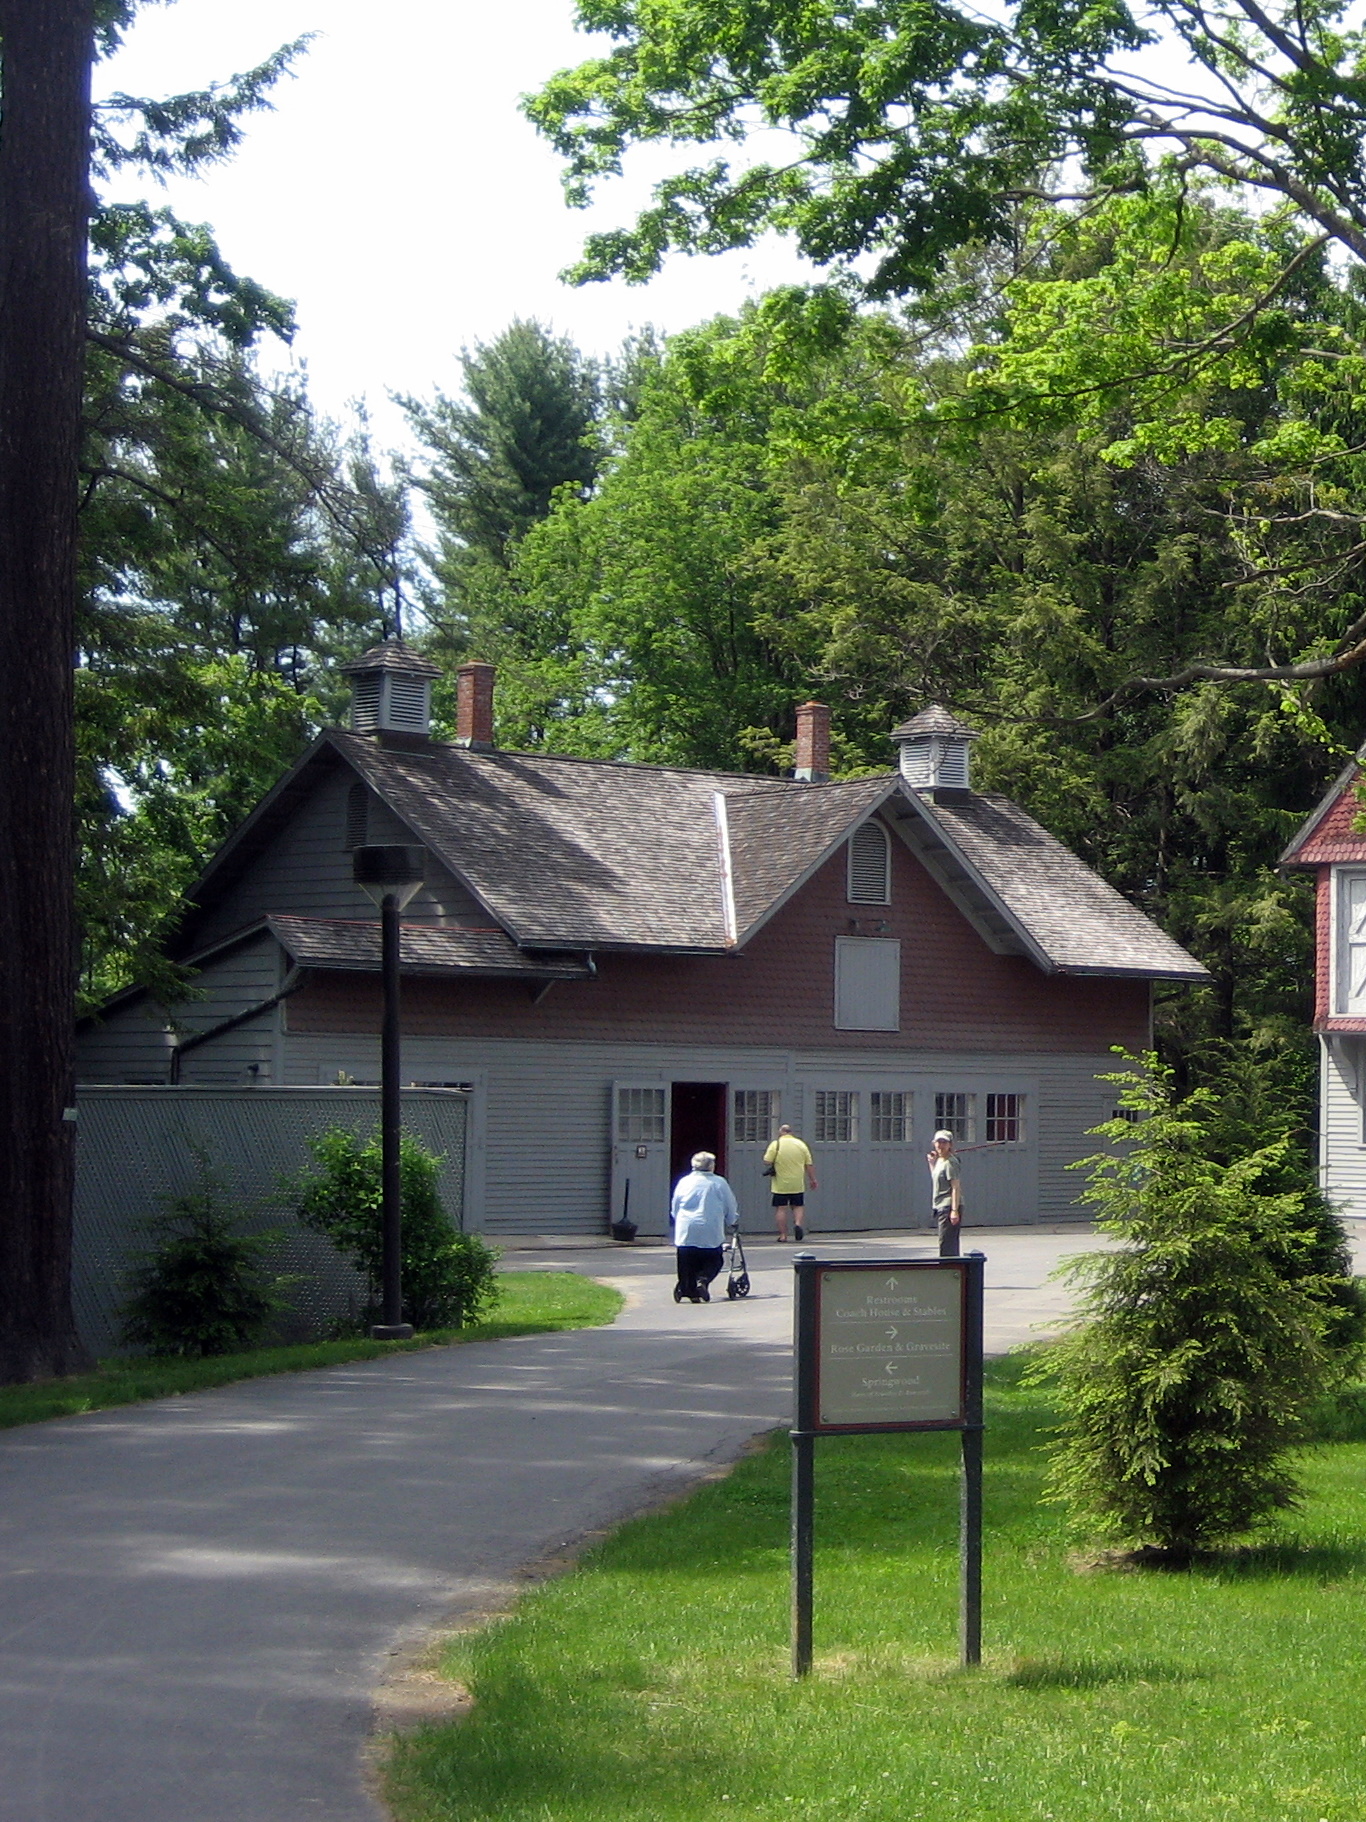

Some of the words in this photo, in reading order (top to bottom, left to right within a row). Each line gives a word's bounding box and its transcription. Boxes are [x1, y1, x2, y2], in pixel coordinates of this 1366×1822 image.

[836, 1307, 867, 1318] Coach
[869, 1307, 900, 1317] House
[902, 1307, 911, 1317] &
[913, 1305, 947, 1316] Stables
[830, 1344, 854, 1354] Rose
[856, 1342, 893, 1353] Garden
[894, 1342, 904, 1352] &
[906, 1341, 951, 1351] Gravesite
[862, 1375, 920, 1389] Springwood
